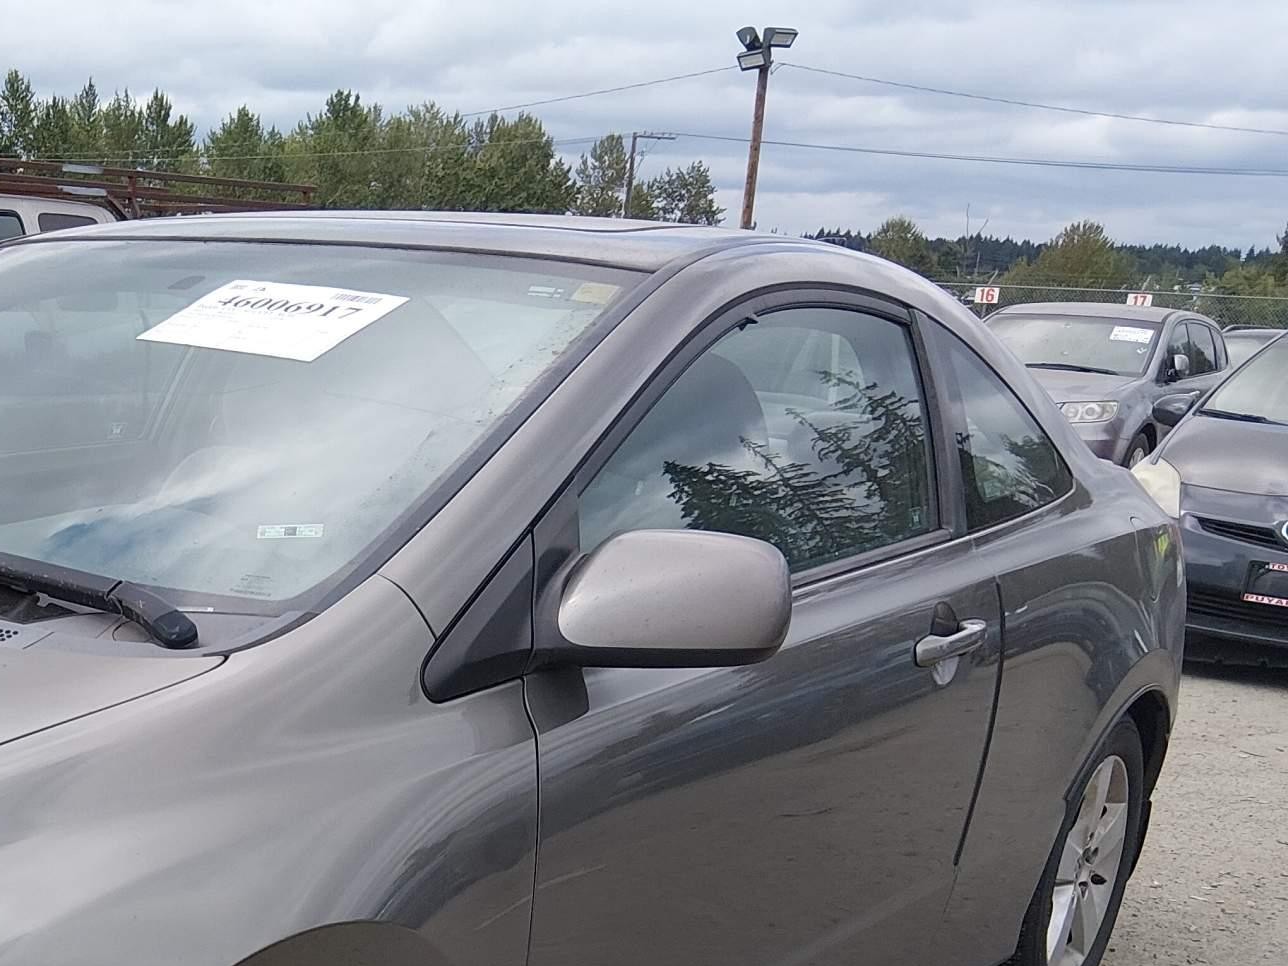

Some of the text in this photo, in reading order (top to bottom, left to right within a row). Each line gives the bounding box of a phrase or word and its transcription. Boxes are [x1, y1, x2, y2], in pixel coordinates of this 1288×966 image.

[979, 288, 996, 303] 16
[1132, 295, 1149, 306] 17
[218, 295, 363, 319] 46006917
